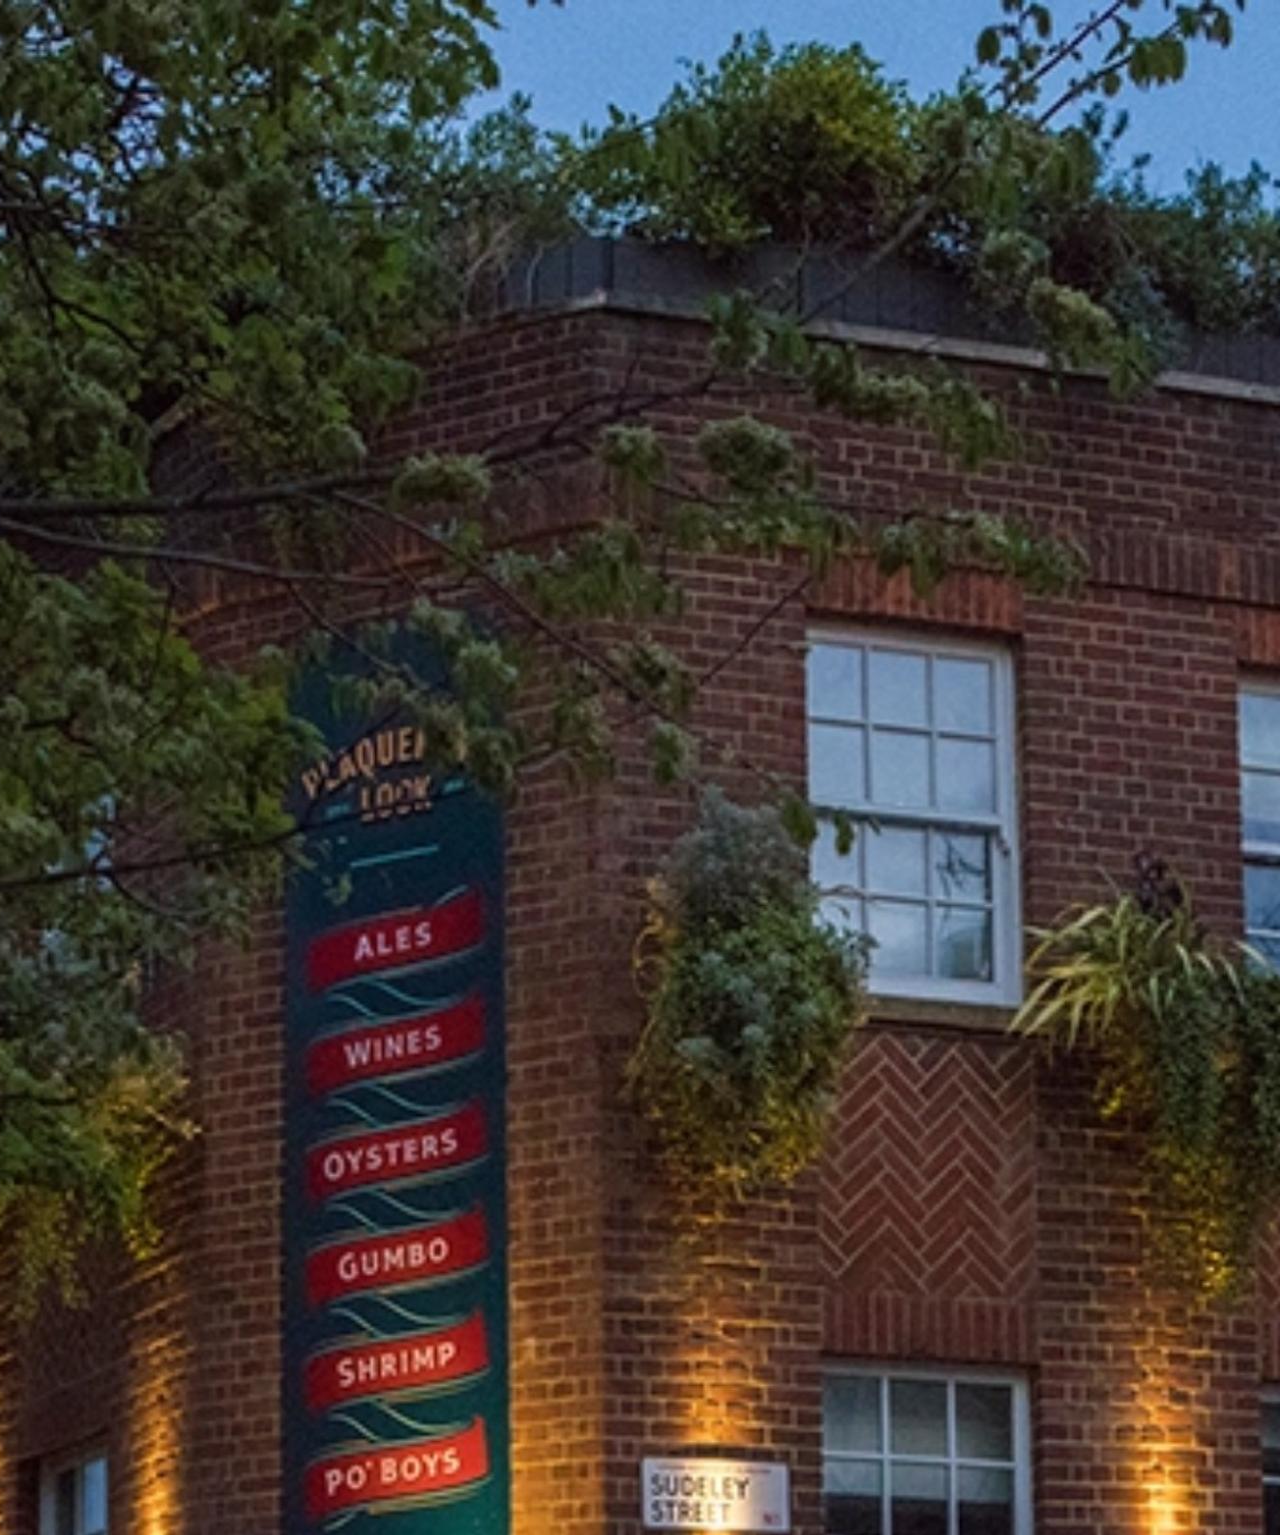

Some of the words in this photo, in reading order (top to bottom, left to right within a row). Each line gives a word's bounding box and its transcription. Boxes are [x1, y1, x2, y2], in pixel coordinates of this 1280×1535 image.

[353, 921, 432, 961] ALES
[343, 1024, 442, 1069] WINES
[323, 1128, 458, 1180] OYSTERS
[338, 1237, 449, 1282] GUMBO
[336, 1341, 456, 1388] SHRIMP
[380, 1447, 461, 1484] BOYS
[650, 1502, 731, 1523] STREET
